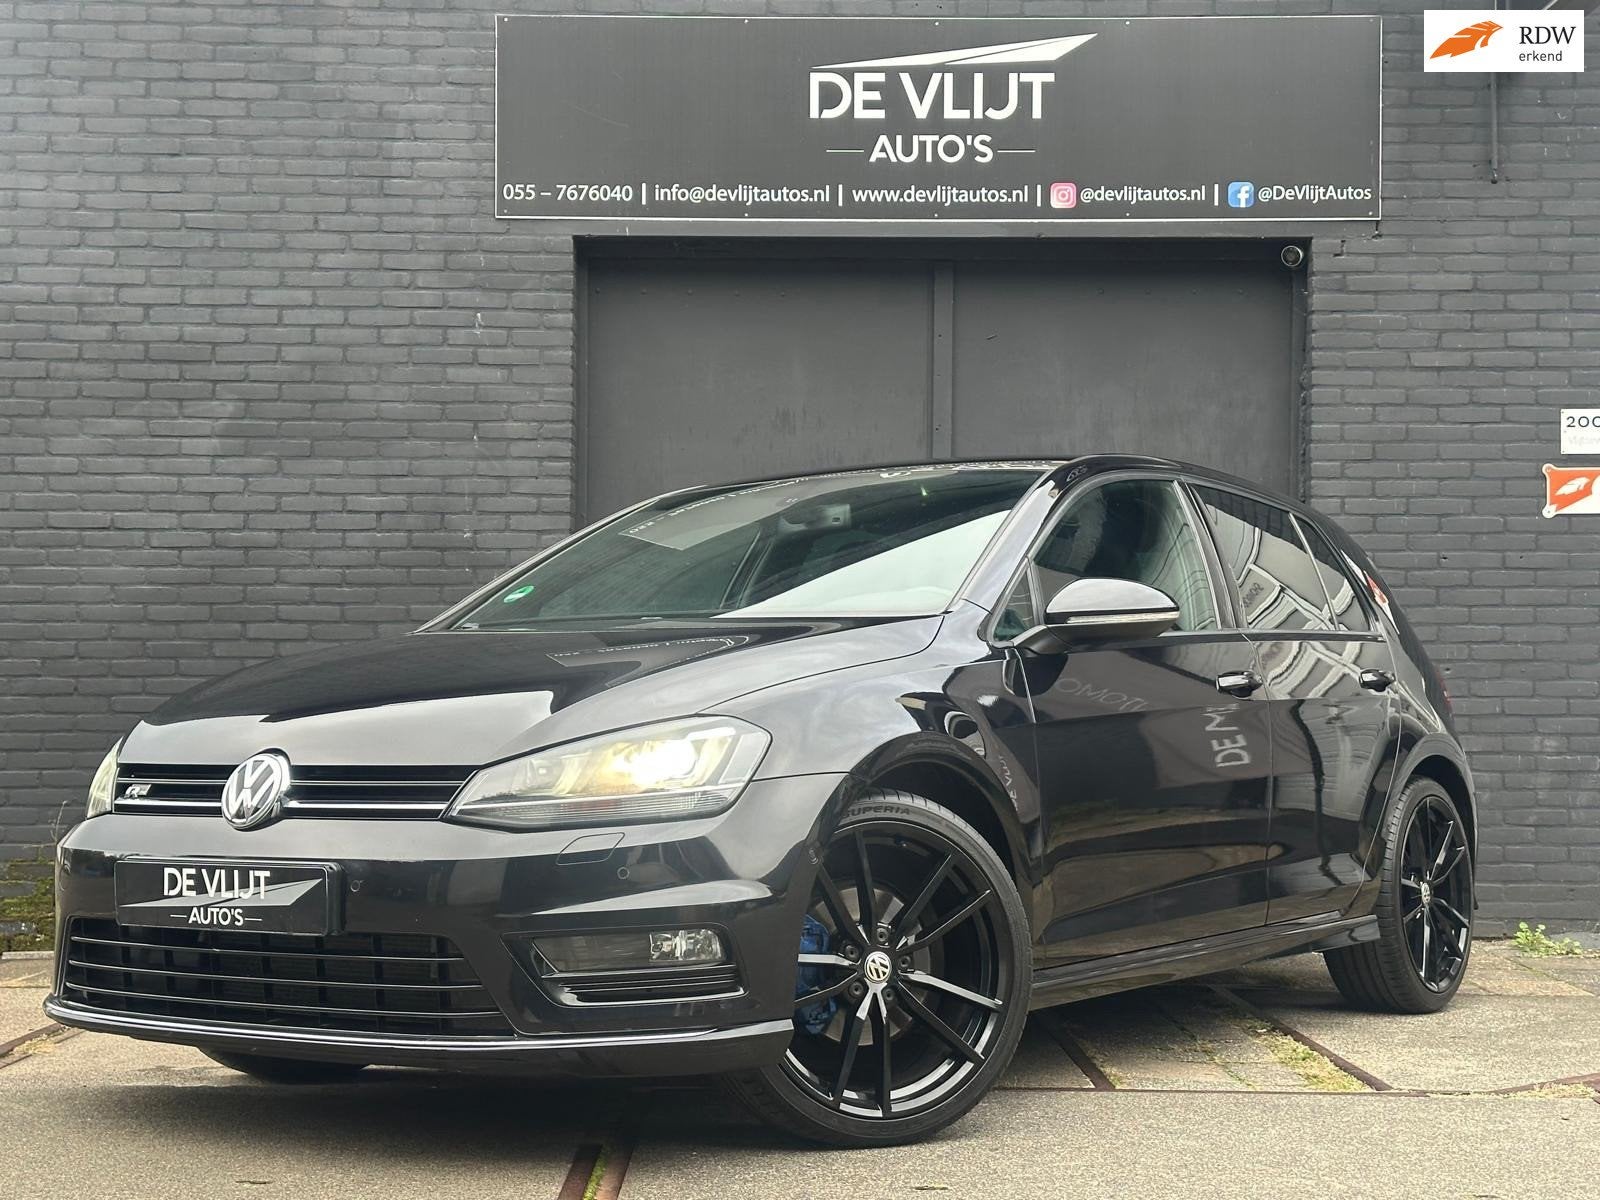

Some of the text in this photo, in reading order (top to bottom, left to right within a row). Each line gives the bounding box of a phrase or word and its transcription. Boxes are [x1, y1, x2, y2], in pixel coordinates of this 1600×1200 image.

[810, 72, 1056, 120] DE VLIJT
[868, 134, 994, 163] AUTO'S
[502, 183, 536, 201] 055
[556, 184, 633, 202] 7676040
[654, 183, 830, 204] info@devlijtautos.nl
[852, 185, 1029, 205] www.devlijtautos.nl
[1080, 185, 1206, 204] @devlijtautos.nl
[1258, 185, 1372, 203] @DeVlijtAutos
[163, 867, 271, 900] DE VLIJT
[188, 907, 244, 927] AUTO'S
